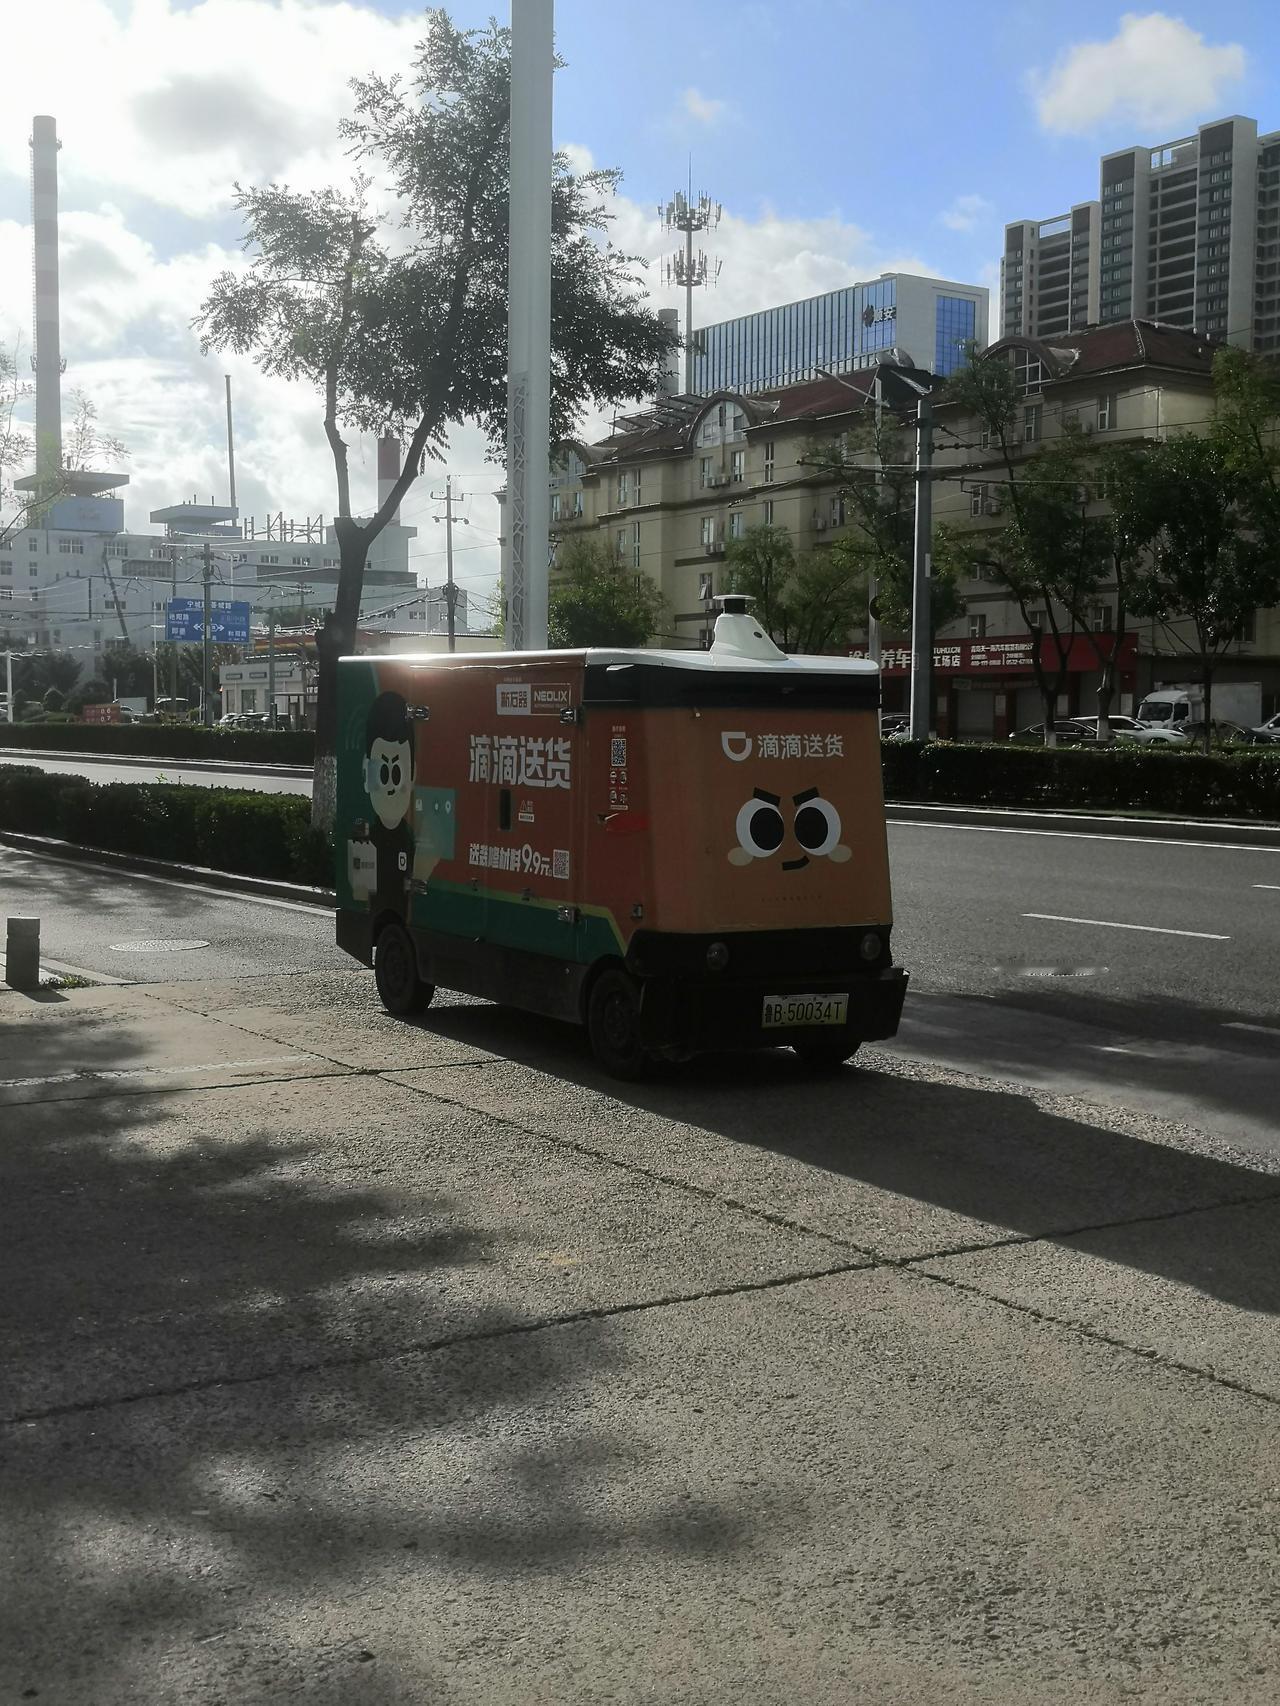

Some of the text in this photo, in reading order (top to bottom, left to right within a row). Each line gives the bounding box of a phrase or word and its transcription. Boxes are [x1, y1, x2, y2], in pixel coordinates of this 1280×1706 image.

[534, 690, 568, 702] NEOLIX
[757, 733, 844, 759] 滴滴送货
[469, 734, 571, 790] 滴滴送货
